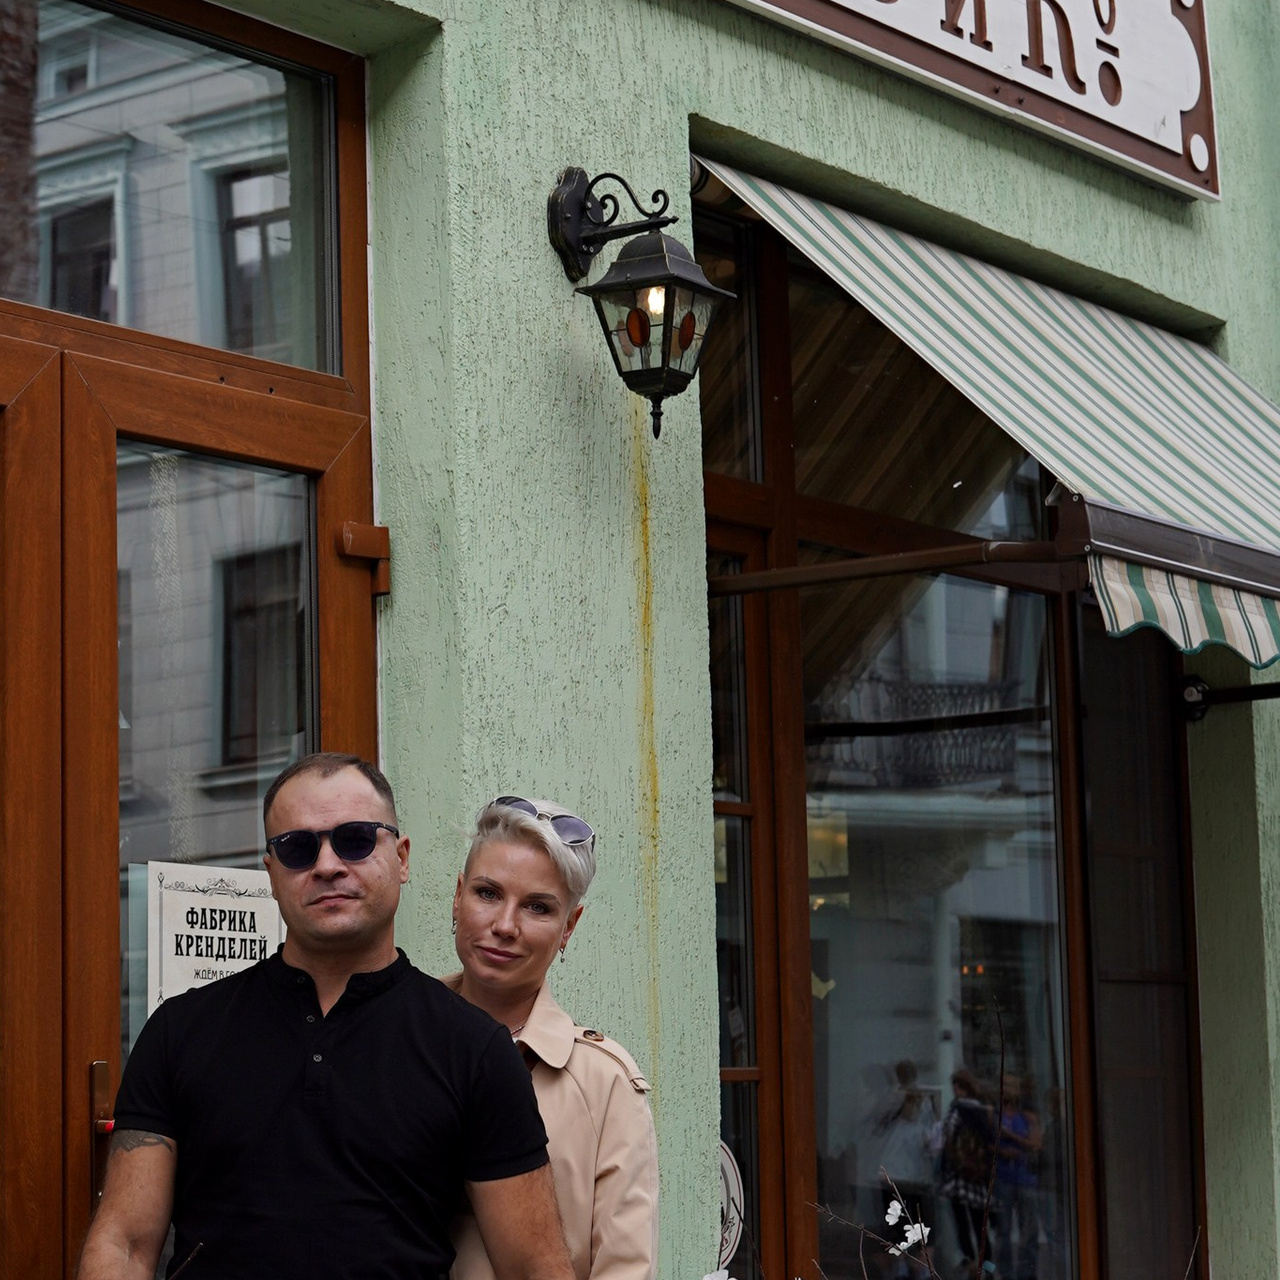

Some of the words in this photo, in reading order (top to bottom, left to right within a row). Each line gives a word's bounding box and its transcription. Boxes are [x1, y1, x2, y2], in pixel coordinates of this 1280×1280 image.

[186, 907, 257, 933] ФАБРИКА
[174, 933, 268, 962] КРЕНДЕЛЕЙ
[194, 967, 217, 980] ЖДЁМ
